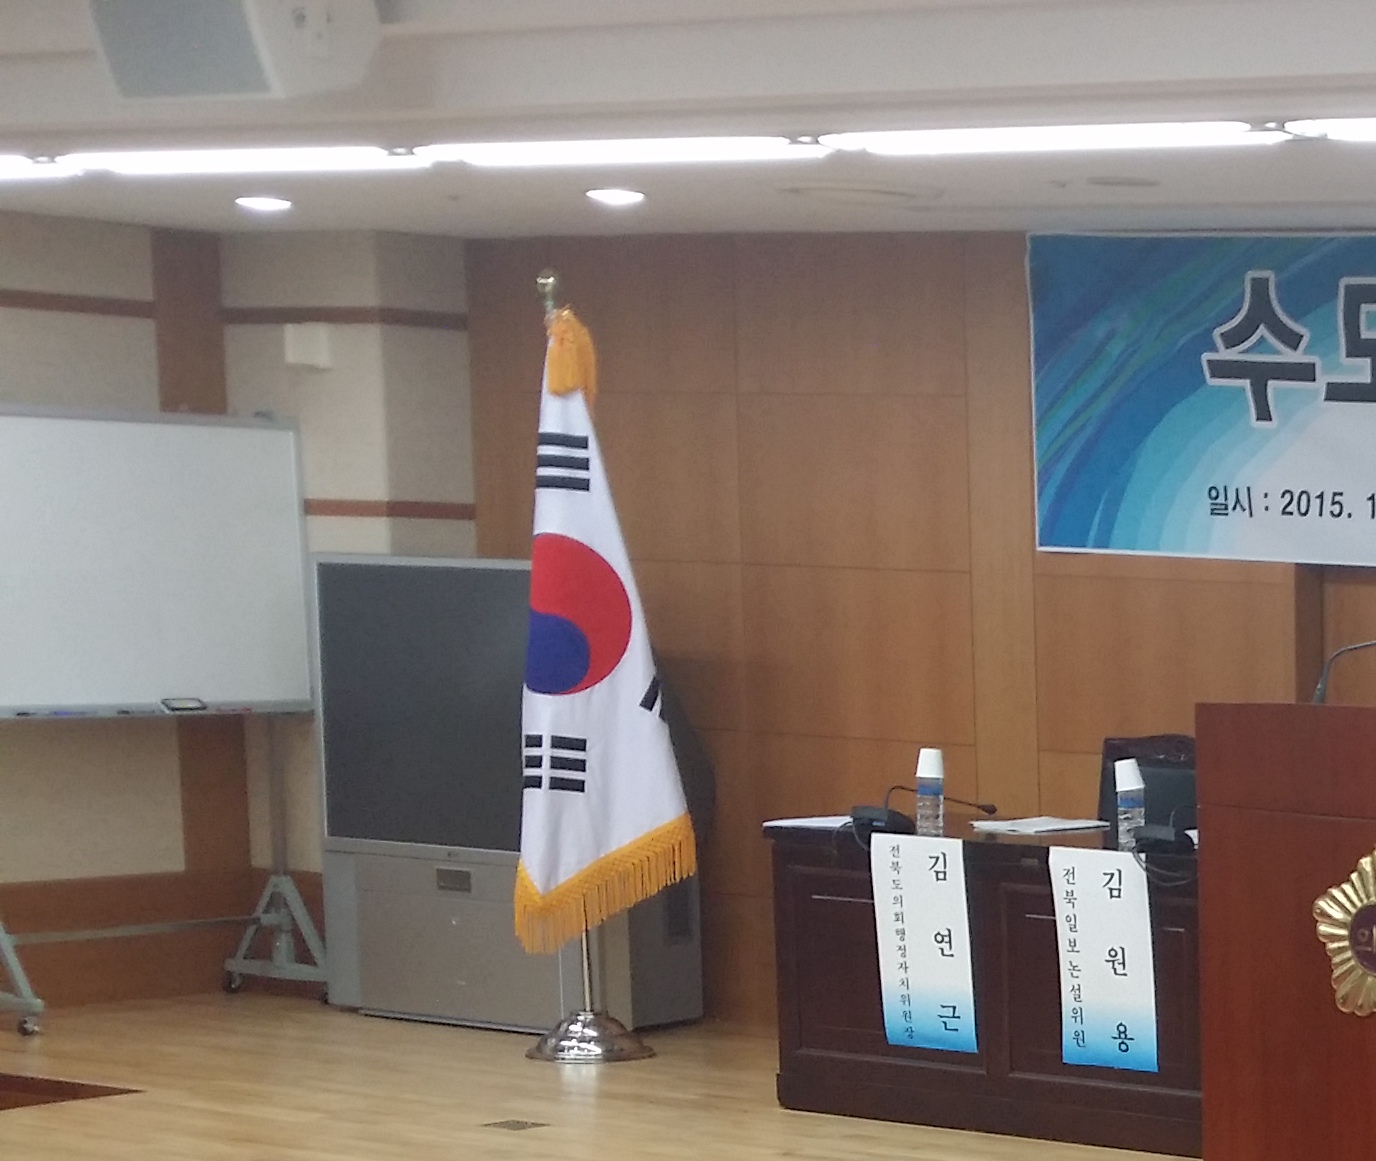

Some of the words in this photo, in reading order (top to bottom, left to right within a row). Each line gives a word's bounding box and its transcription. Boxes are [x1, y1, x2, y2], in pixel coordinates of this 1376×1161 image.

[1207, 485, 1254, 518] 일시
[1280, 490, 1353, 519] 2015.
[928, 852, 961, 1032] 김연근
[1062, 867, 1087, 1049] 전북일보논설위원
[1101, 868, 1136, 1054] 김원용
